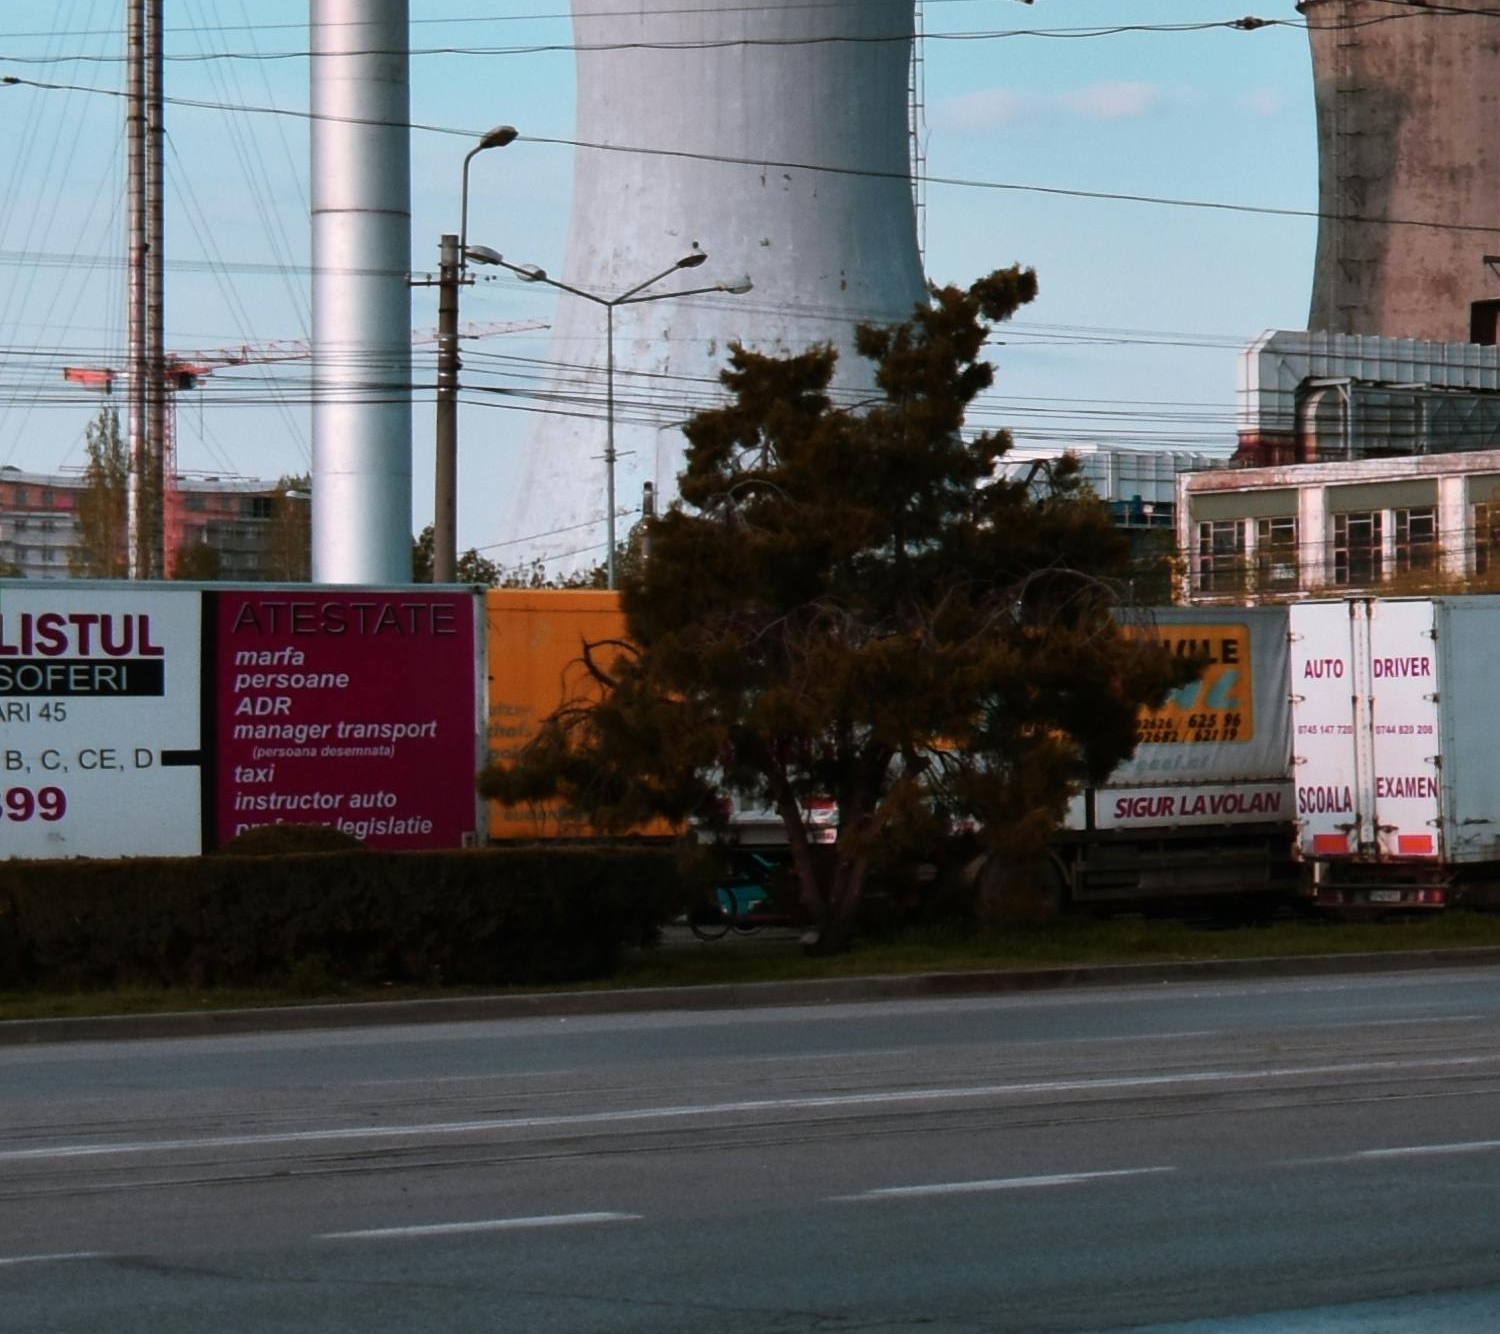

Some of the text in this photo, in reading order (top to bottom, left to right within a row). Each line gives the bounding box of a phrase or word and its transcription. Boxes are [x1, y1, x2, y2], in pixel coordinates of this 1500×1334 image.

[231, 601, 457, 635] ATESTATE
[0, 613, 164, 656] LISTUL
[234, 647, 305, 666] marfa
[1304, 657, 1430, 679] AUTO DRIVER
[234, 672, 350, 693] persoane
[39, 702, 66, 722] 45
[235, 696, 292, 716] ADR
[233, 720, 437, 744] manager transport
[1320, 725, 1332, 735] 147
[6, 748, 153, 772] B, C, CE, D
[252, 743, 395, 759] (persoana desemnata)
[234, 764, 275, 783] taxi
[1376, 777, 1438, 798] EXAMEN
[0, 787, 67, 822] 99
[234, 790, 397, 811] instructor auto
[1114, 792, 1282, 819] SIGUR LA VOLAN
[1299, 786, 1353, 814] SCOALA
[337, 816, 433, 840] legislatie
